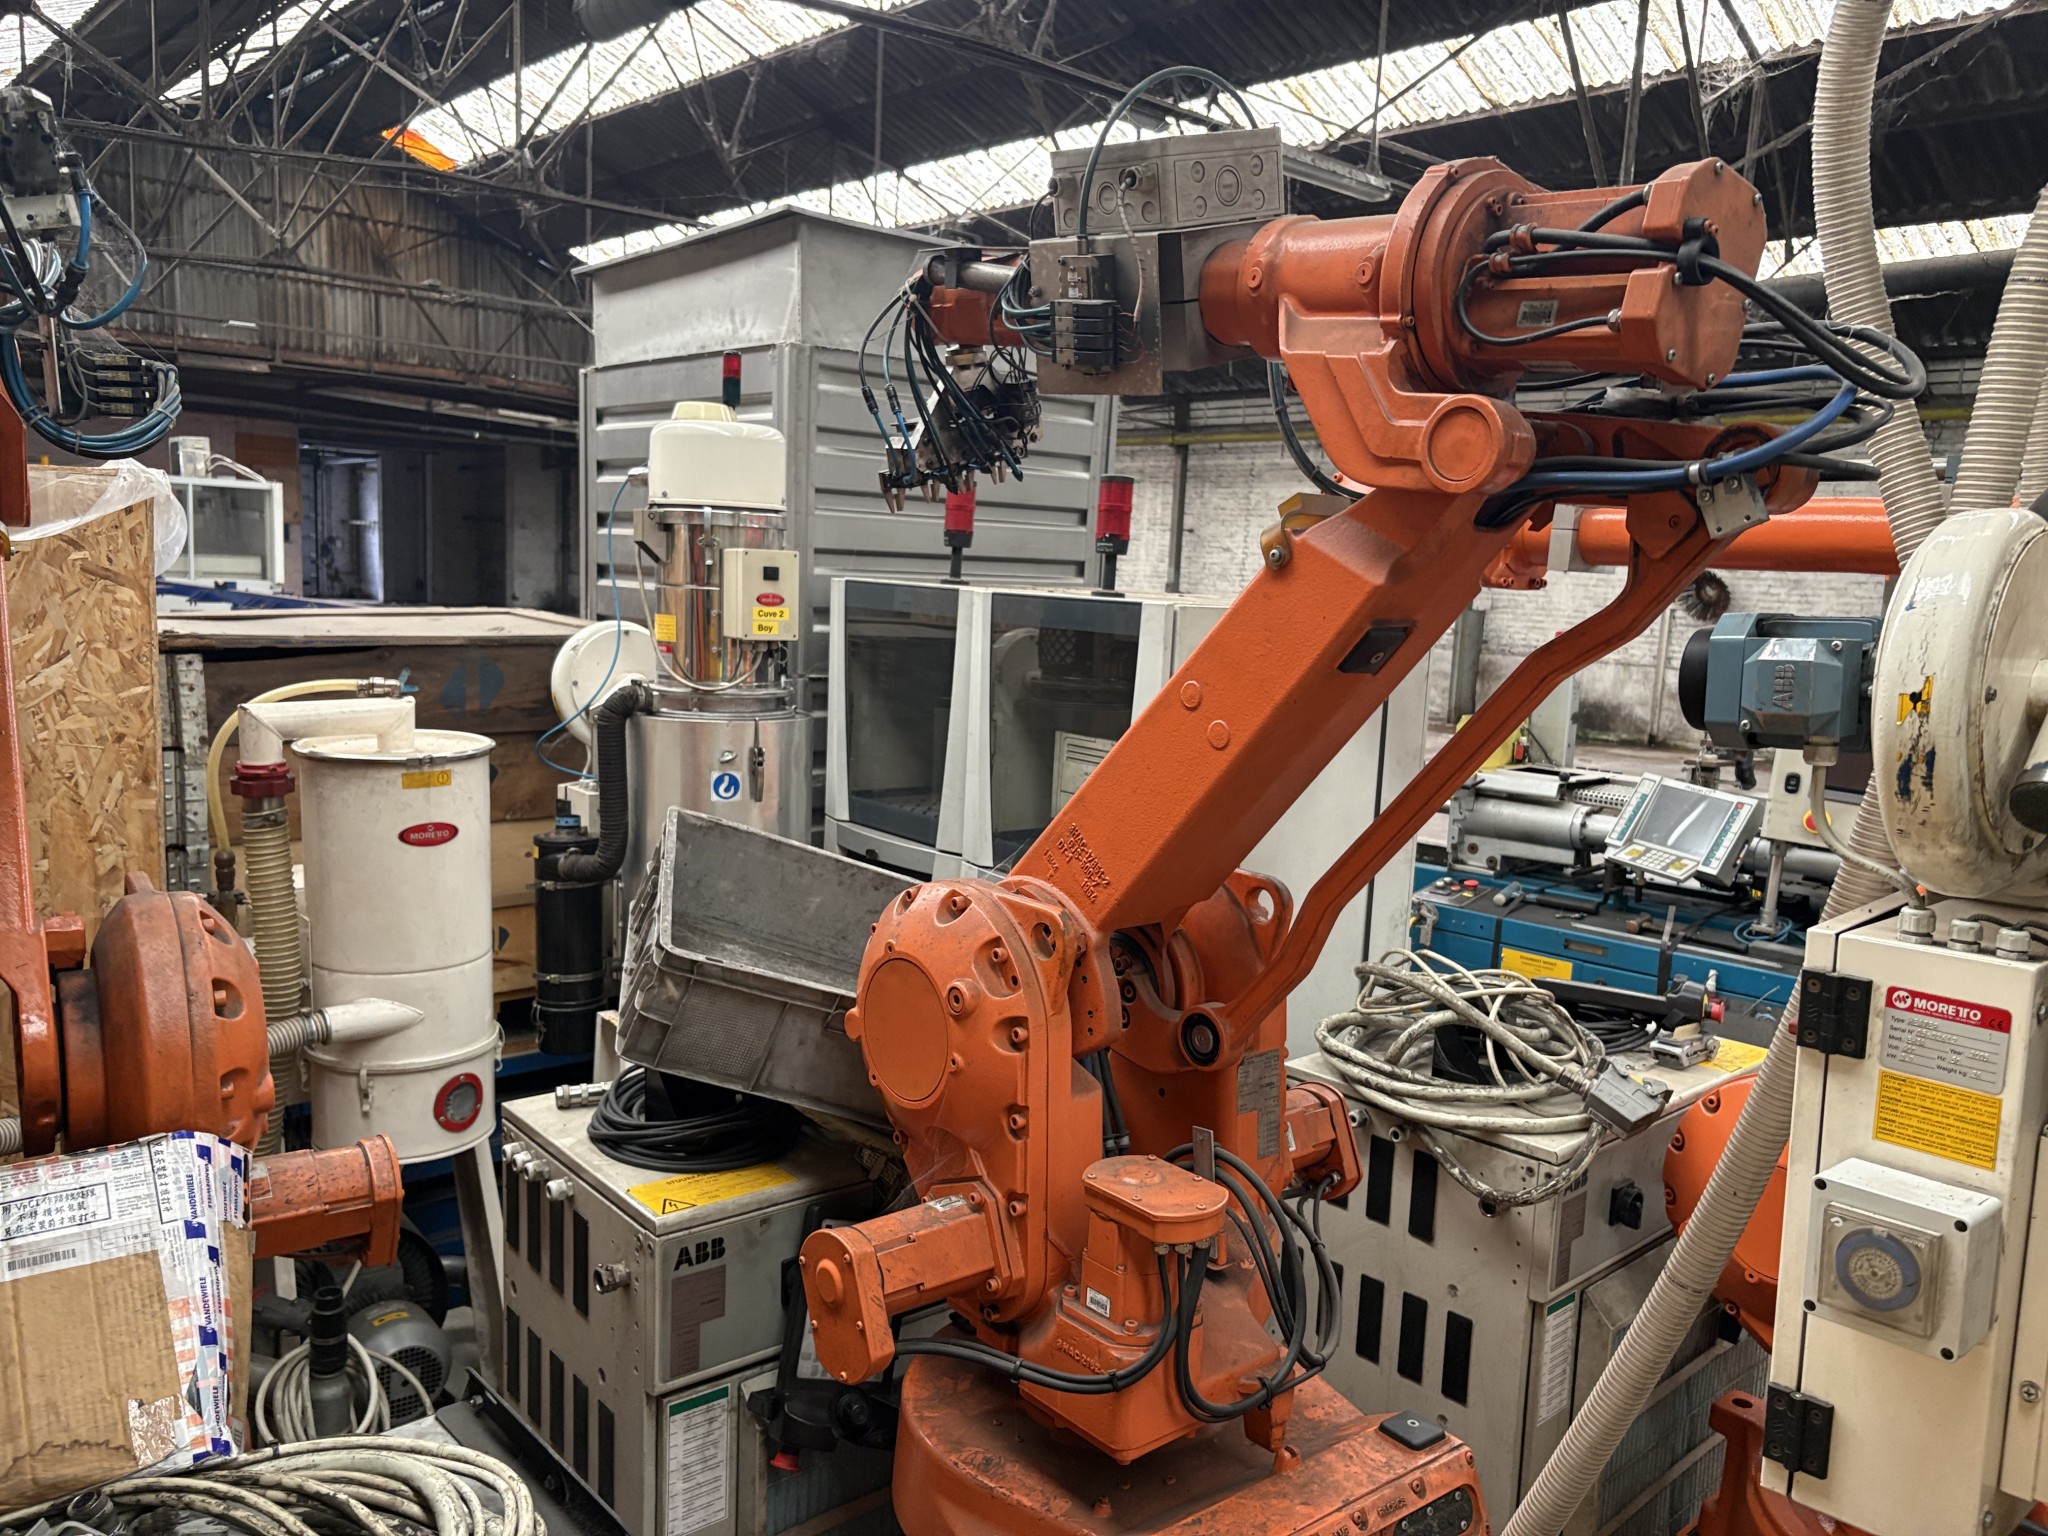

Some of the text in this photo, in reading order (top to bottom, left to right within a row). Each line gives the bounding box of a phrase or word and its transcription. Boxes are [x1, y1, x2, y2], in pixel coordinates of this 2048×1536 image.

[758, 610, 784, 618] Cuve 2
[758, 624, 773, 634] Boy
[1772, 664, 1796, 712] ABB
[410, 829, 450, 840] MORETTO
[1914, 998, 1982, 1021] MORETTO
[1936, 1065, 1957, 1075] Weight
[186, 1174, 198, 1220] VANDEWIELE
[674, 1236, 726, 1272] ABB
[199, 1276, 212, 1326] VANDEWIELE
